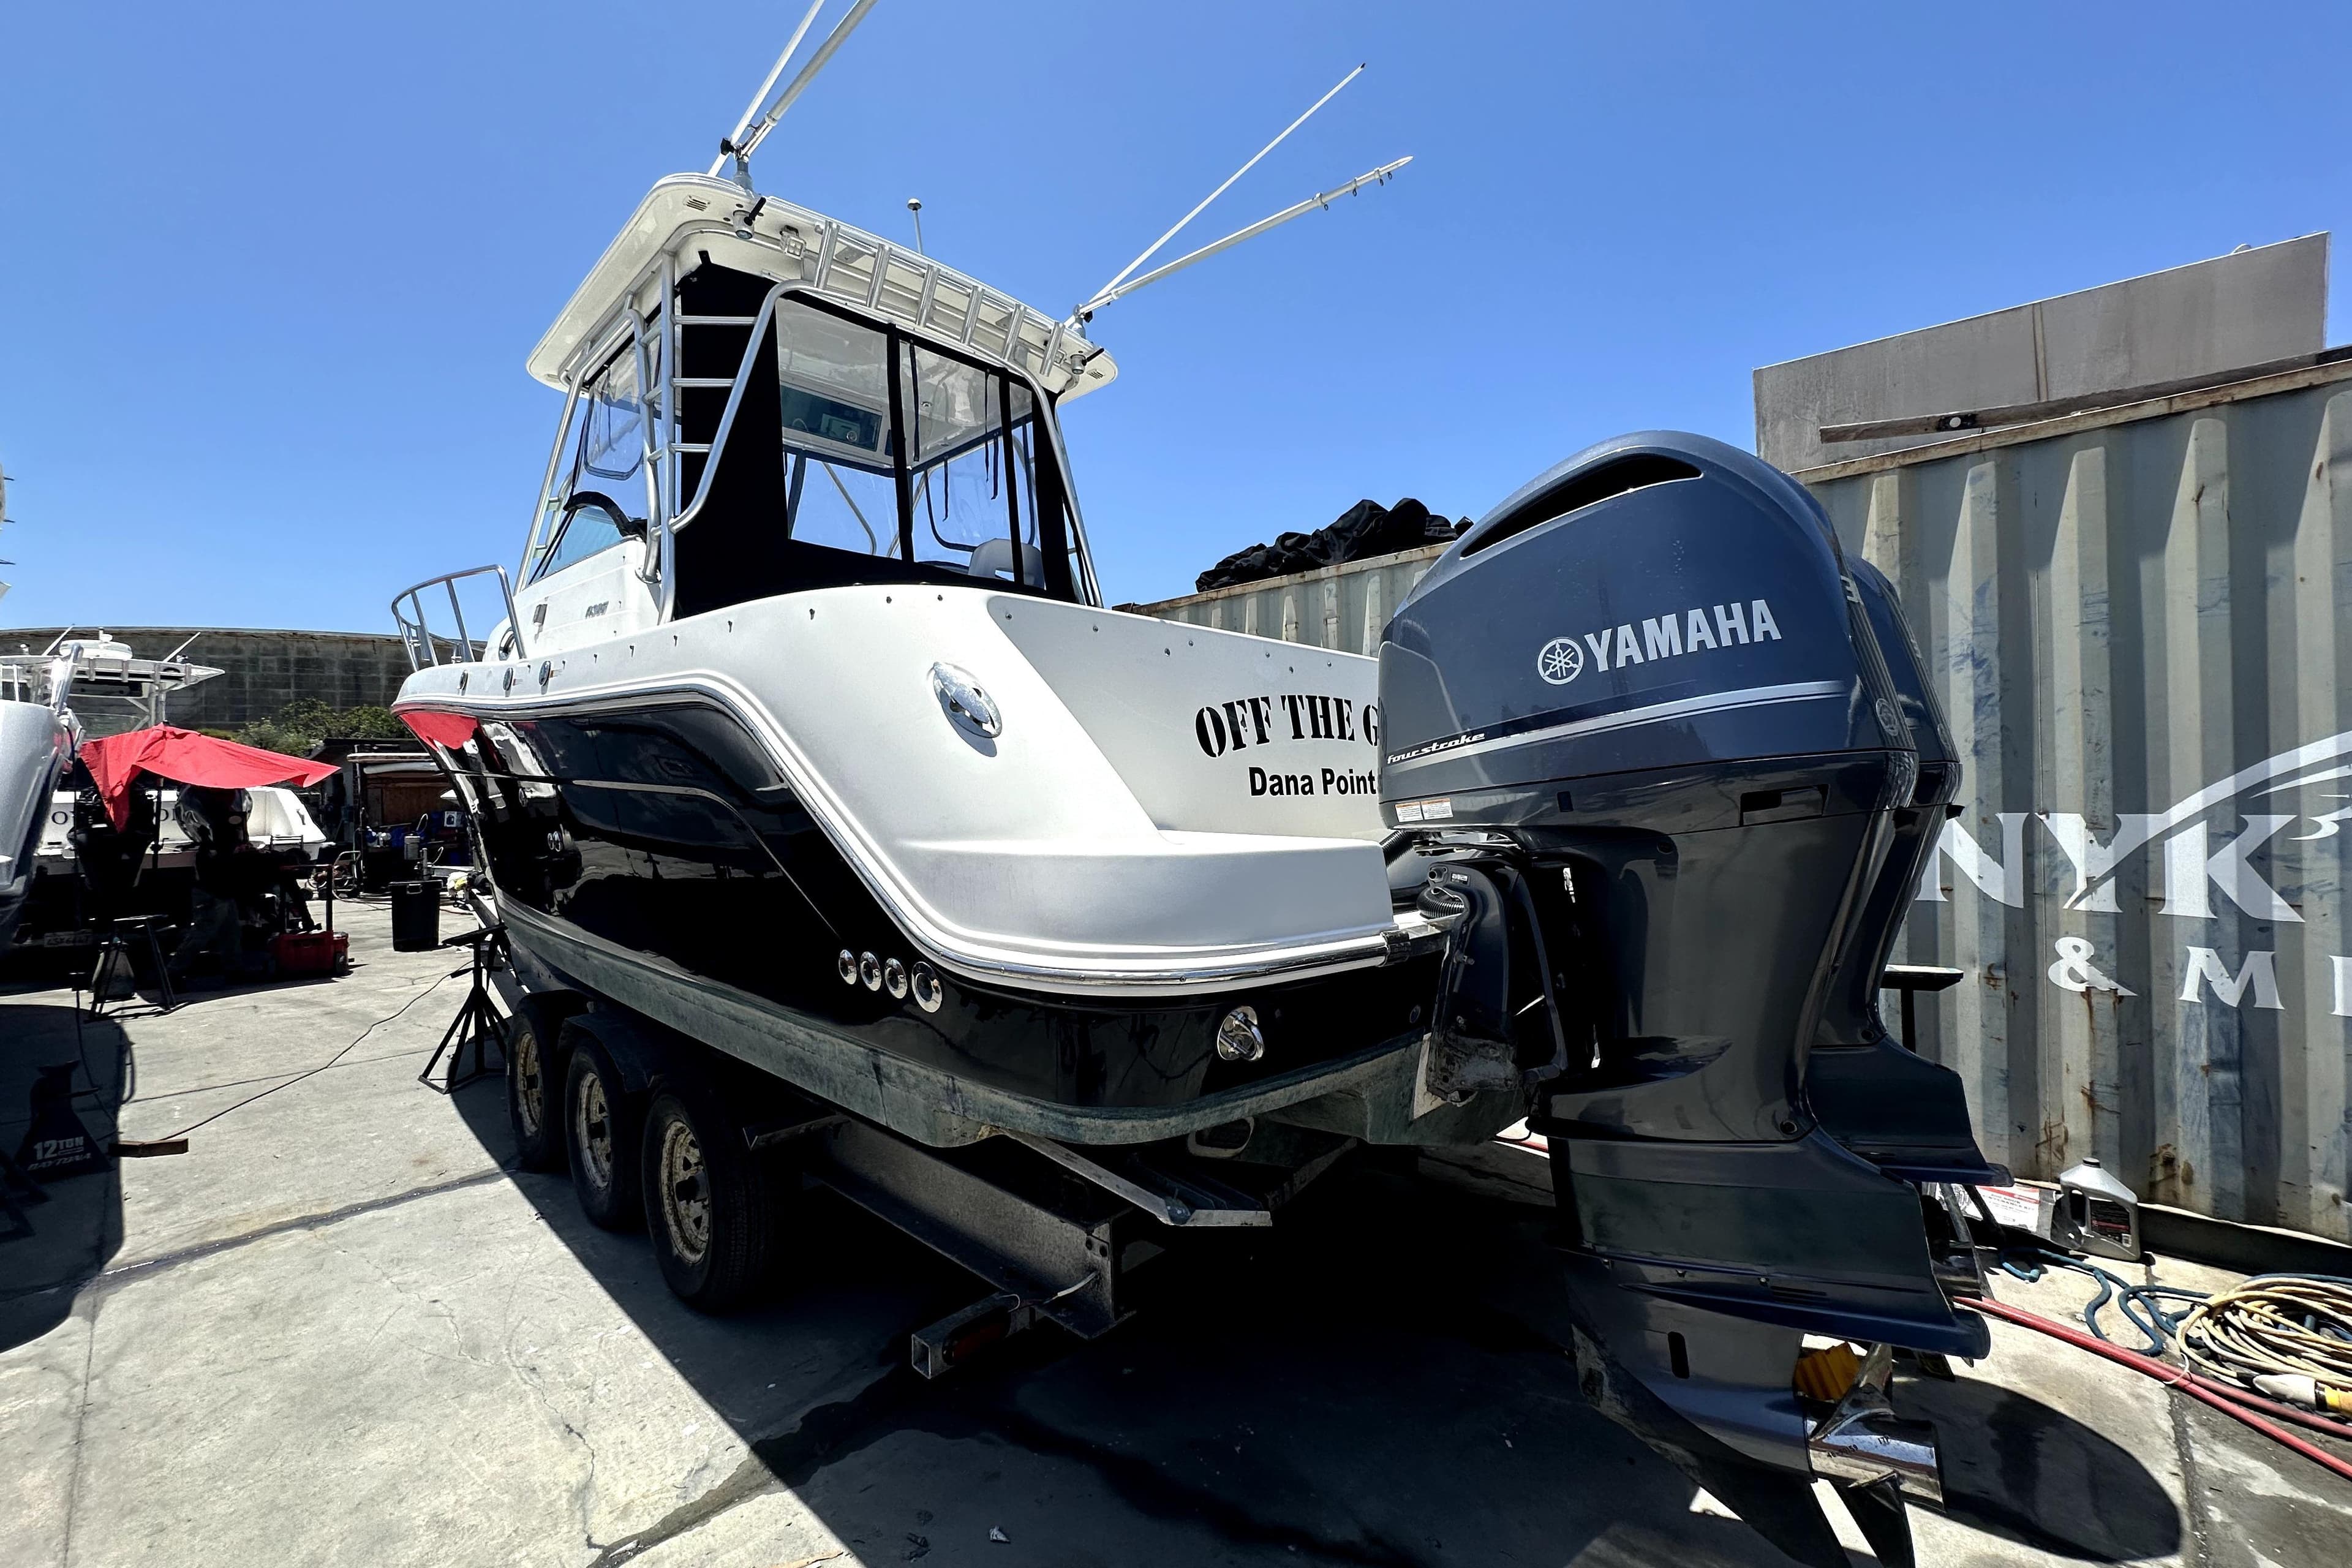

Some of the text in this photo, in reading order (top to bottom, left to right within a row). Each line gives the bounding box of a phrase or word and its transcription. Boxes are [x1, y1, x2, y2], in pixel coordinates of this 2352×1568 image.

[1584, 599, 1782, 673] YAMAHA
[1195, 696, 1272, 758] OFF
[1280, 695, 1355, 742] THE
[1249, 766, 1377, 796] Dana Point
[2048, 936, 2138, 996] &
[34, 1140, 58, 1161] 12
